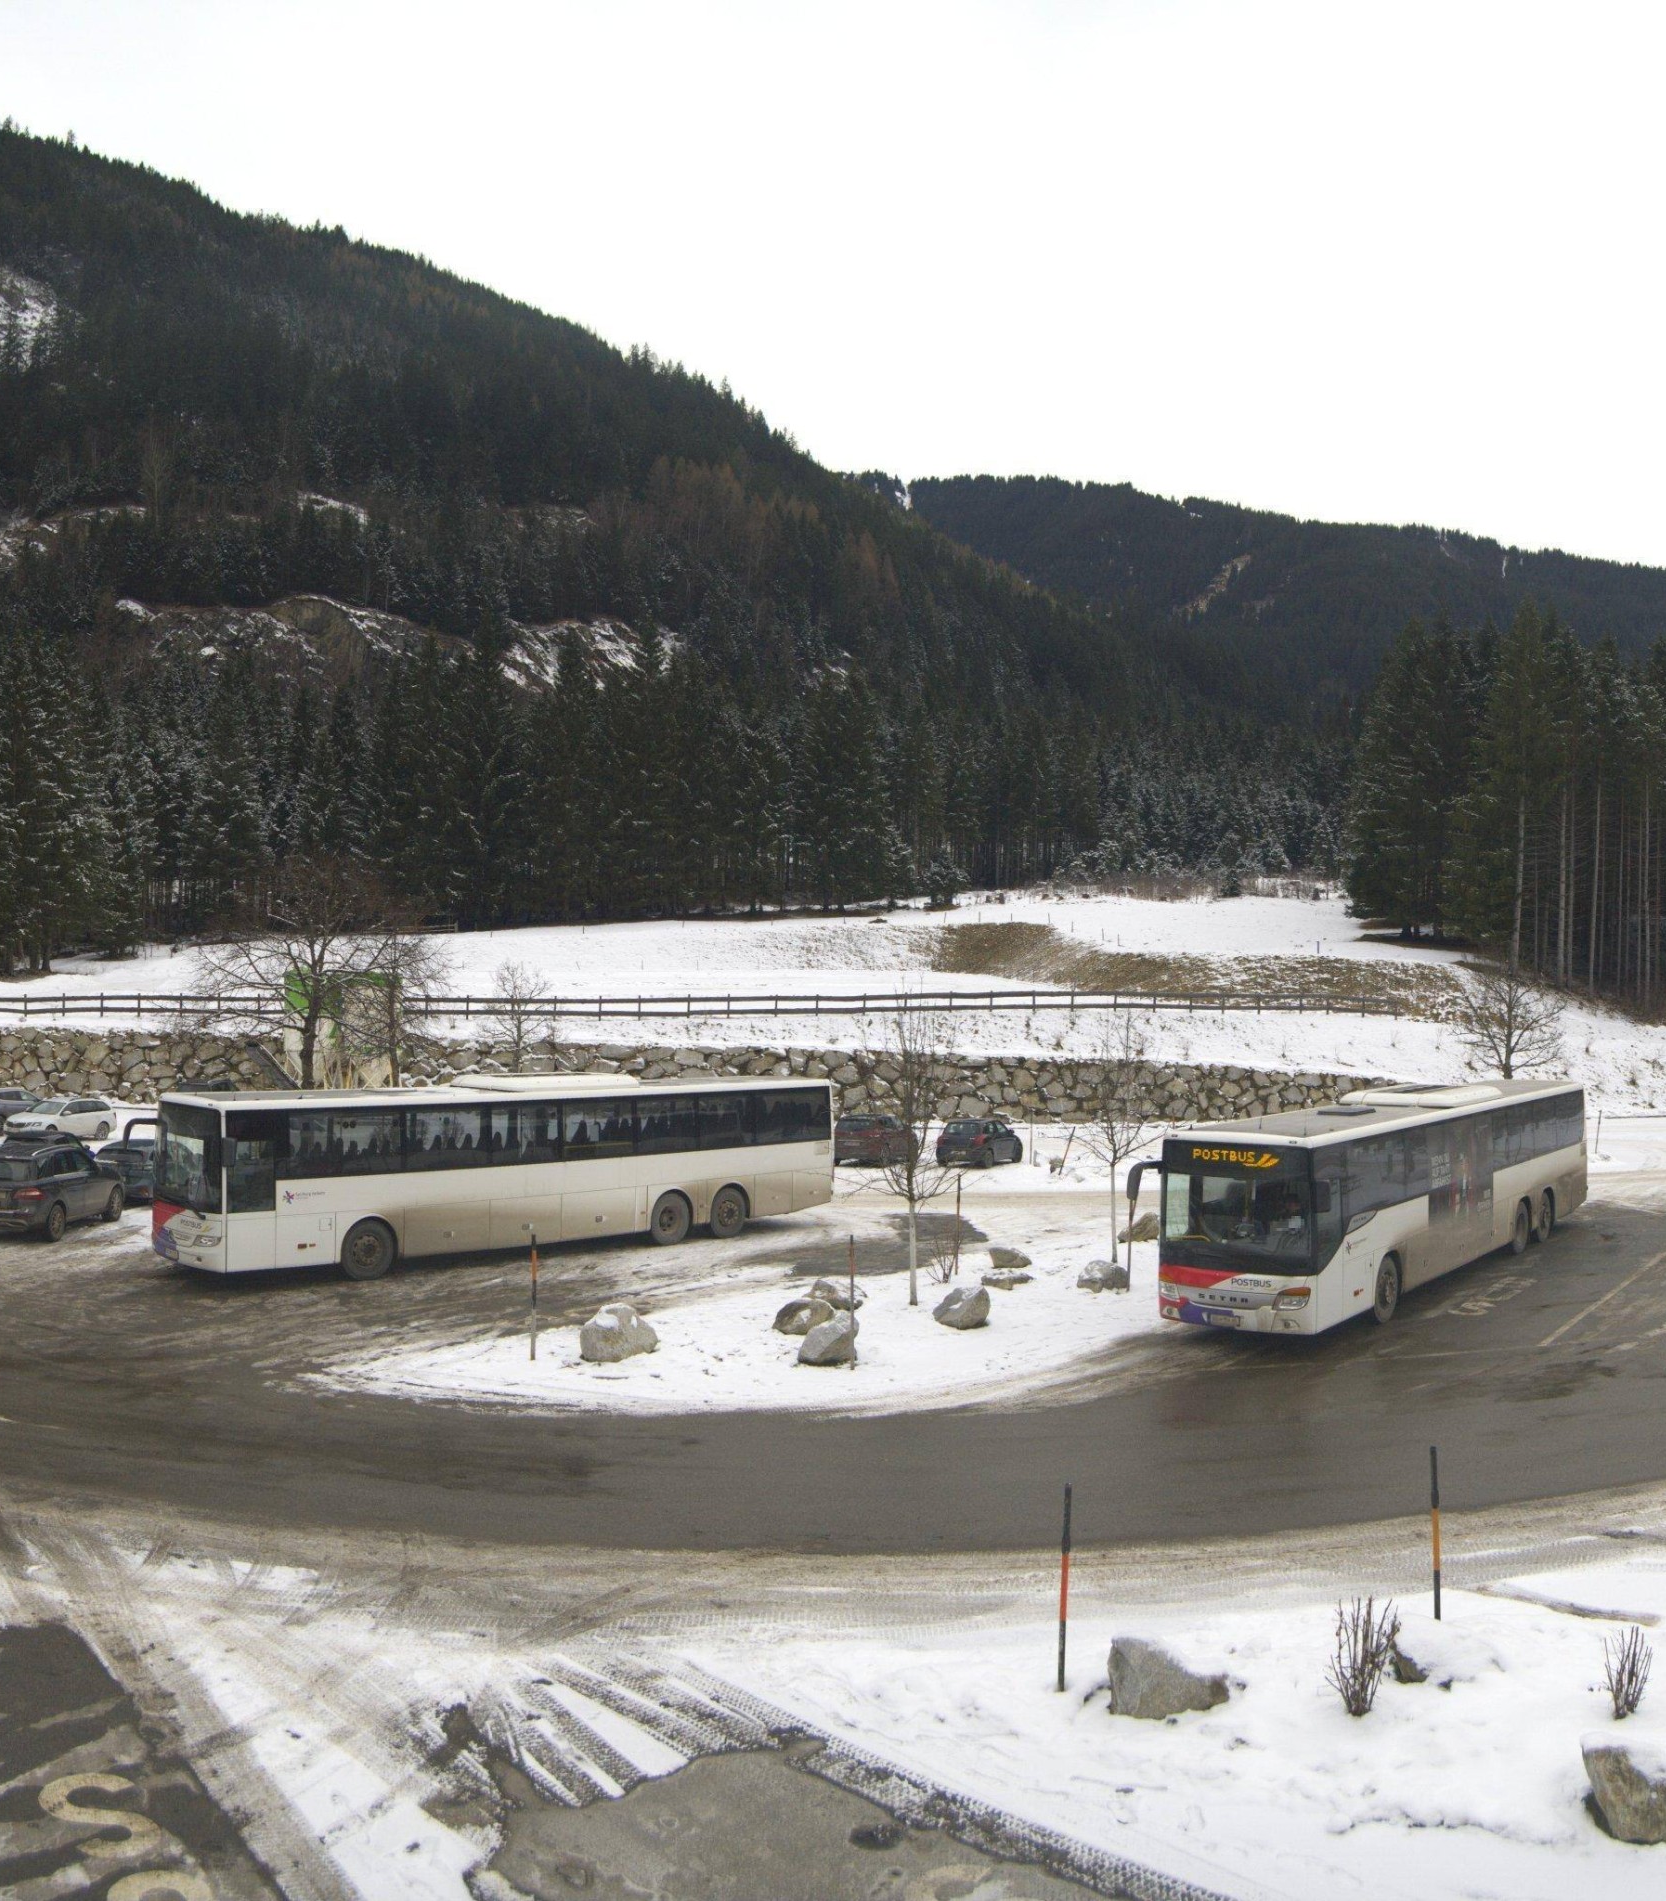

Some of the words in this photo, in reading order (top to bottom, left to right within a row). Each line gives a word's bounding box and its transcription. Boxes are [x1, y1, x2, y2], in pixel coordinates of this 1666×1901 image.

[1192, 1148, 1256, 1163] POSTBUS
[1231, 1277, 1272, 1288] POSTBUS
[1198, 1292, 1249, 1304] SETRA
